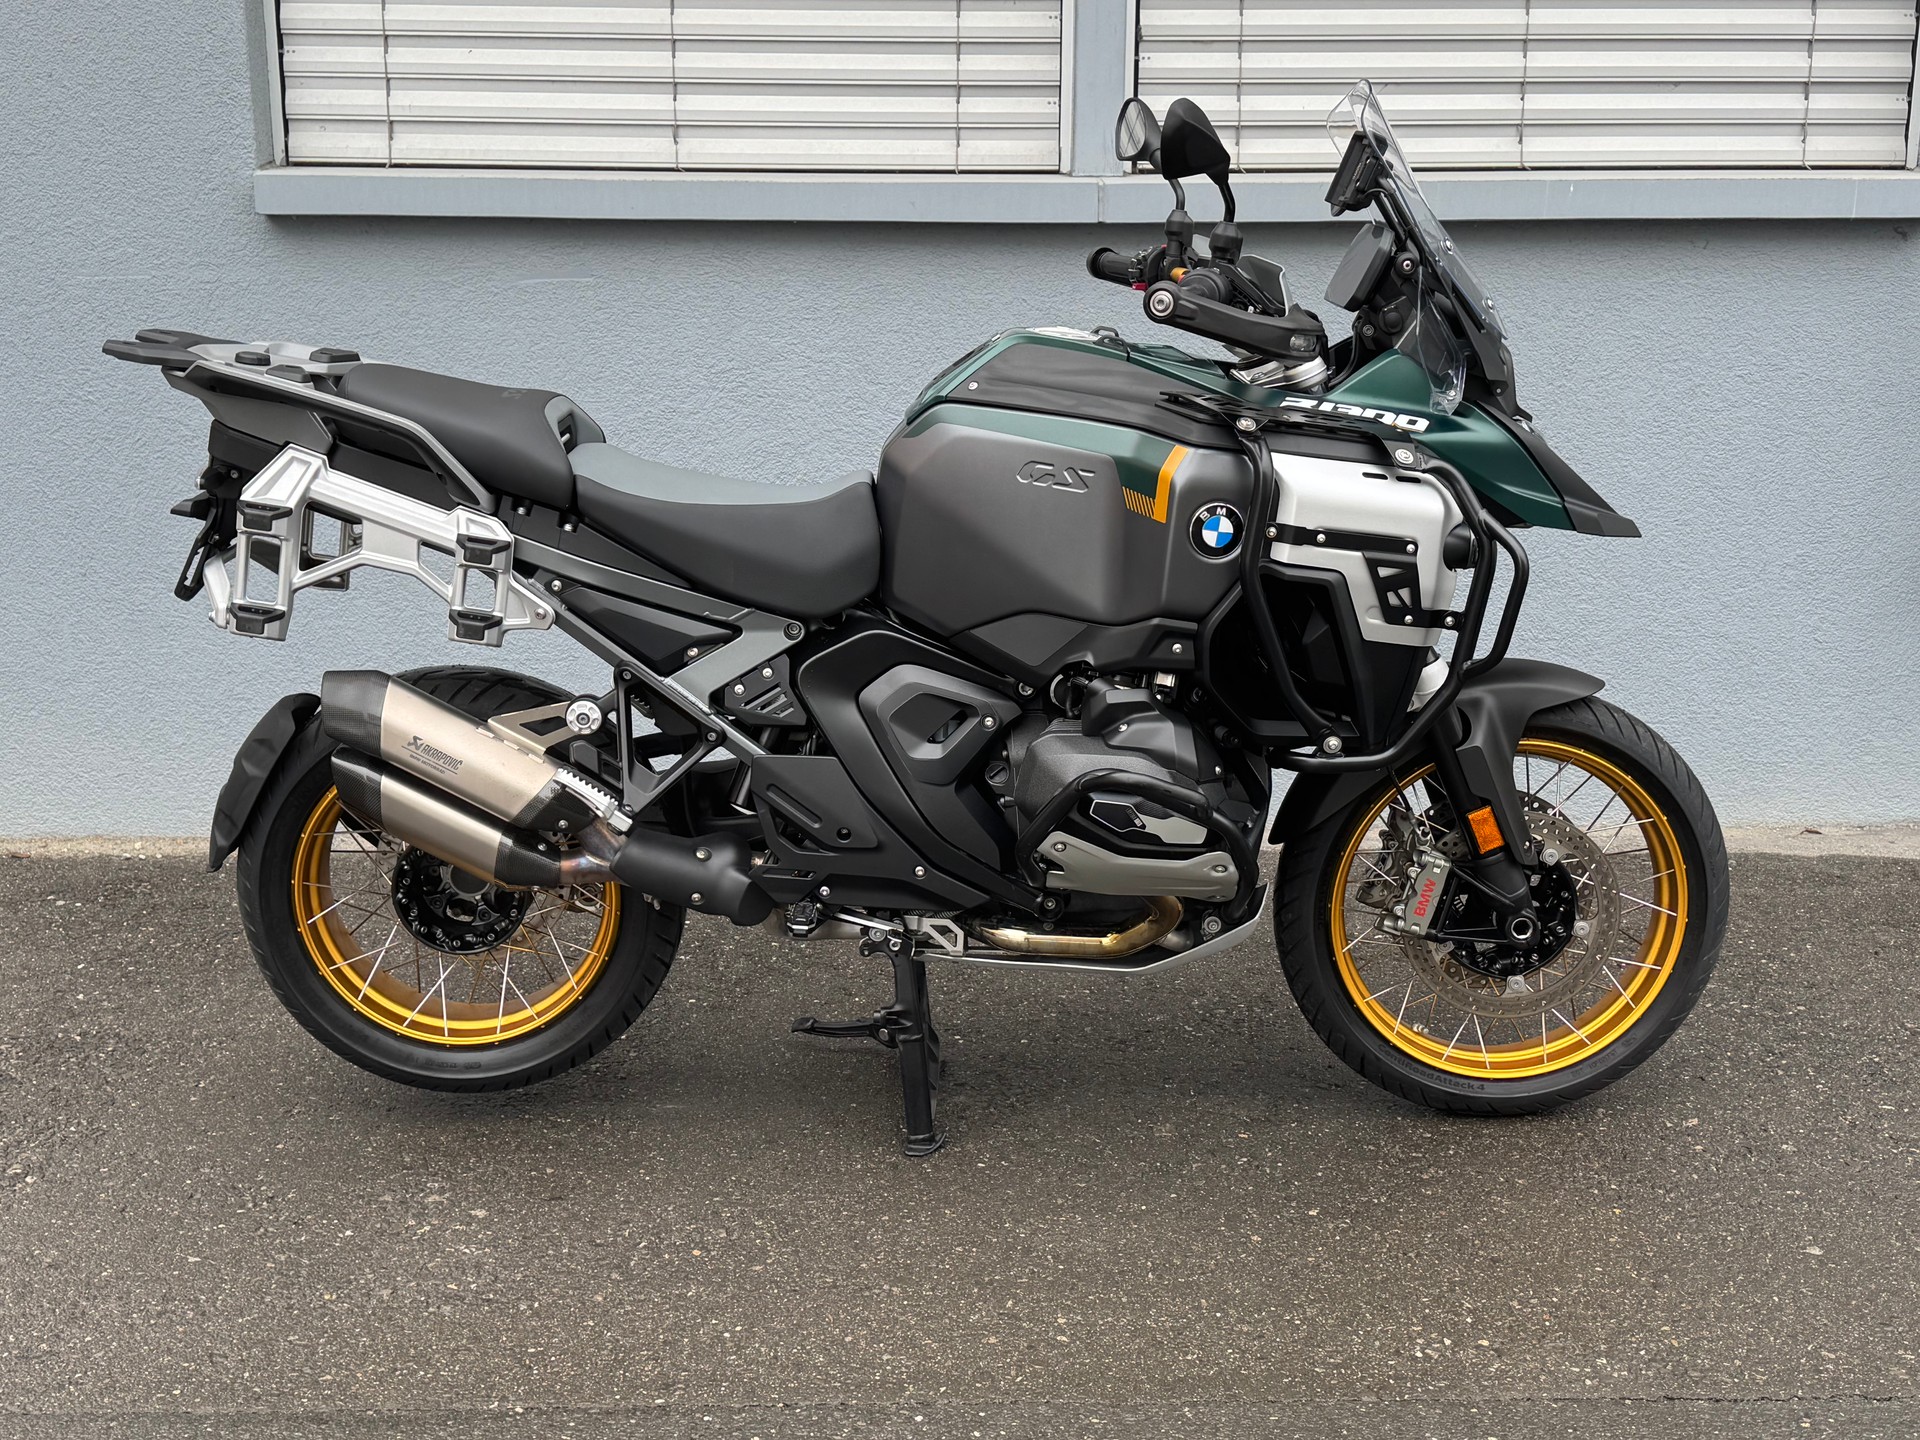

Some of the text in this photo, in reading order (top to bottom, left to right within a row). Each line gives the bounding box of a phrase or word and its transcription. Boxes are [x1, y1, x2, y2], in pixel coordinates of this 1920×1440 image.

[1016, 460, 1096, 493] GS
[1199, 506, 1241, 527] BM
[1413, 878, 1436, 917] BMW
[1476, 1083, 1486, 1091] 4
